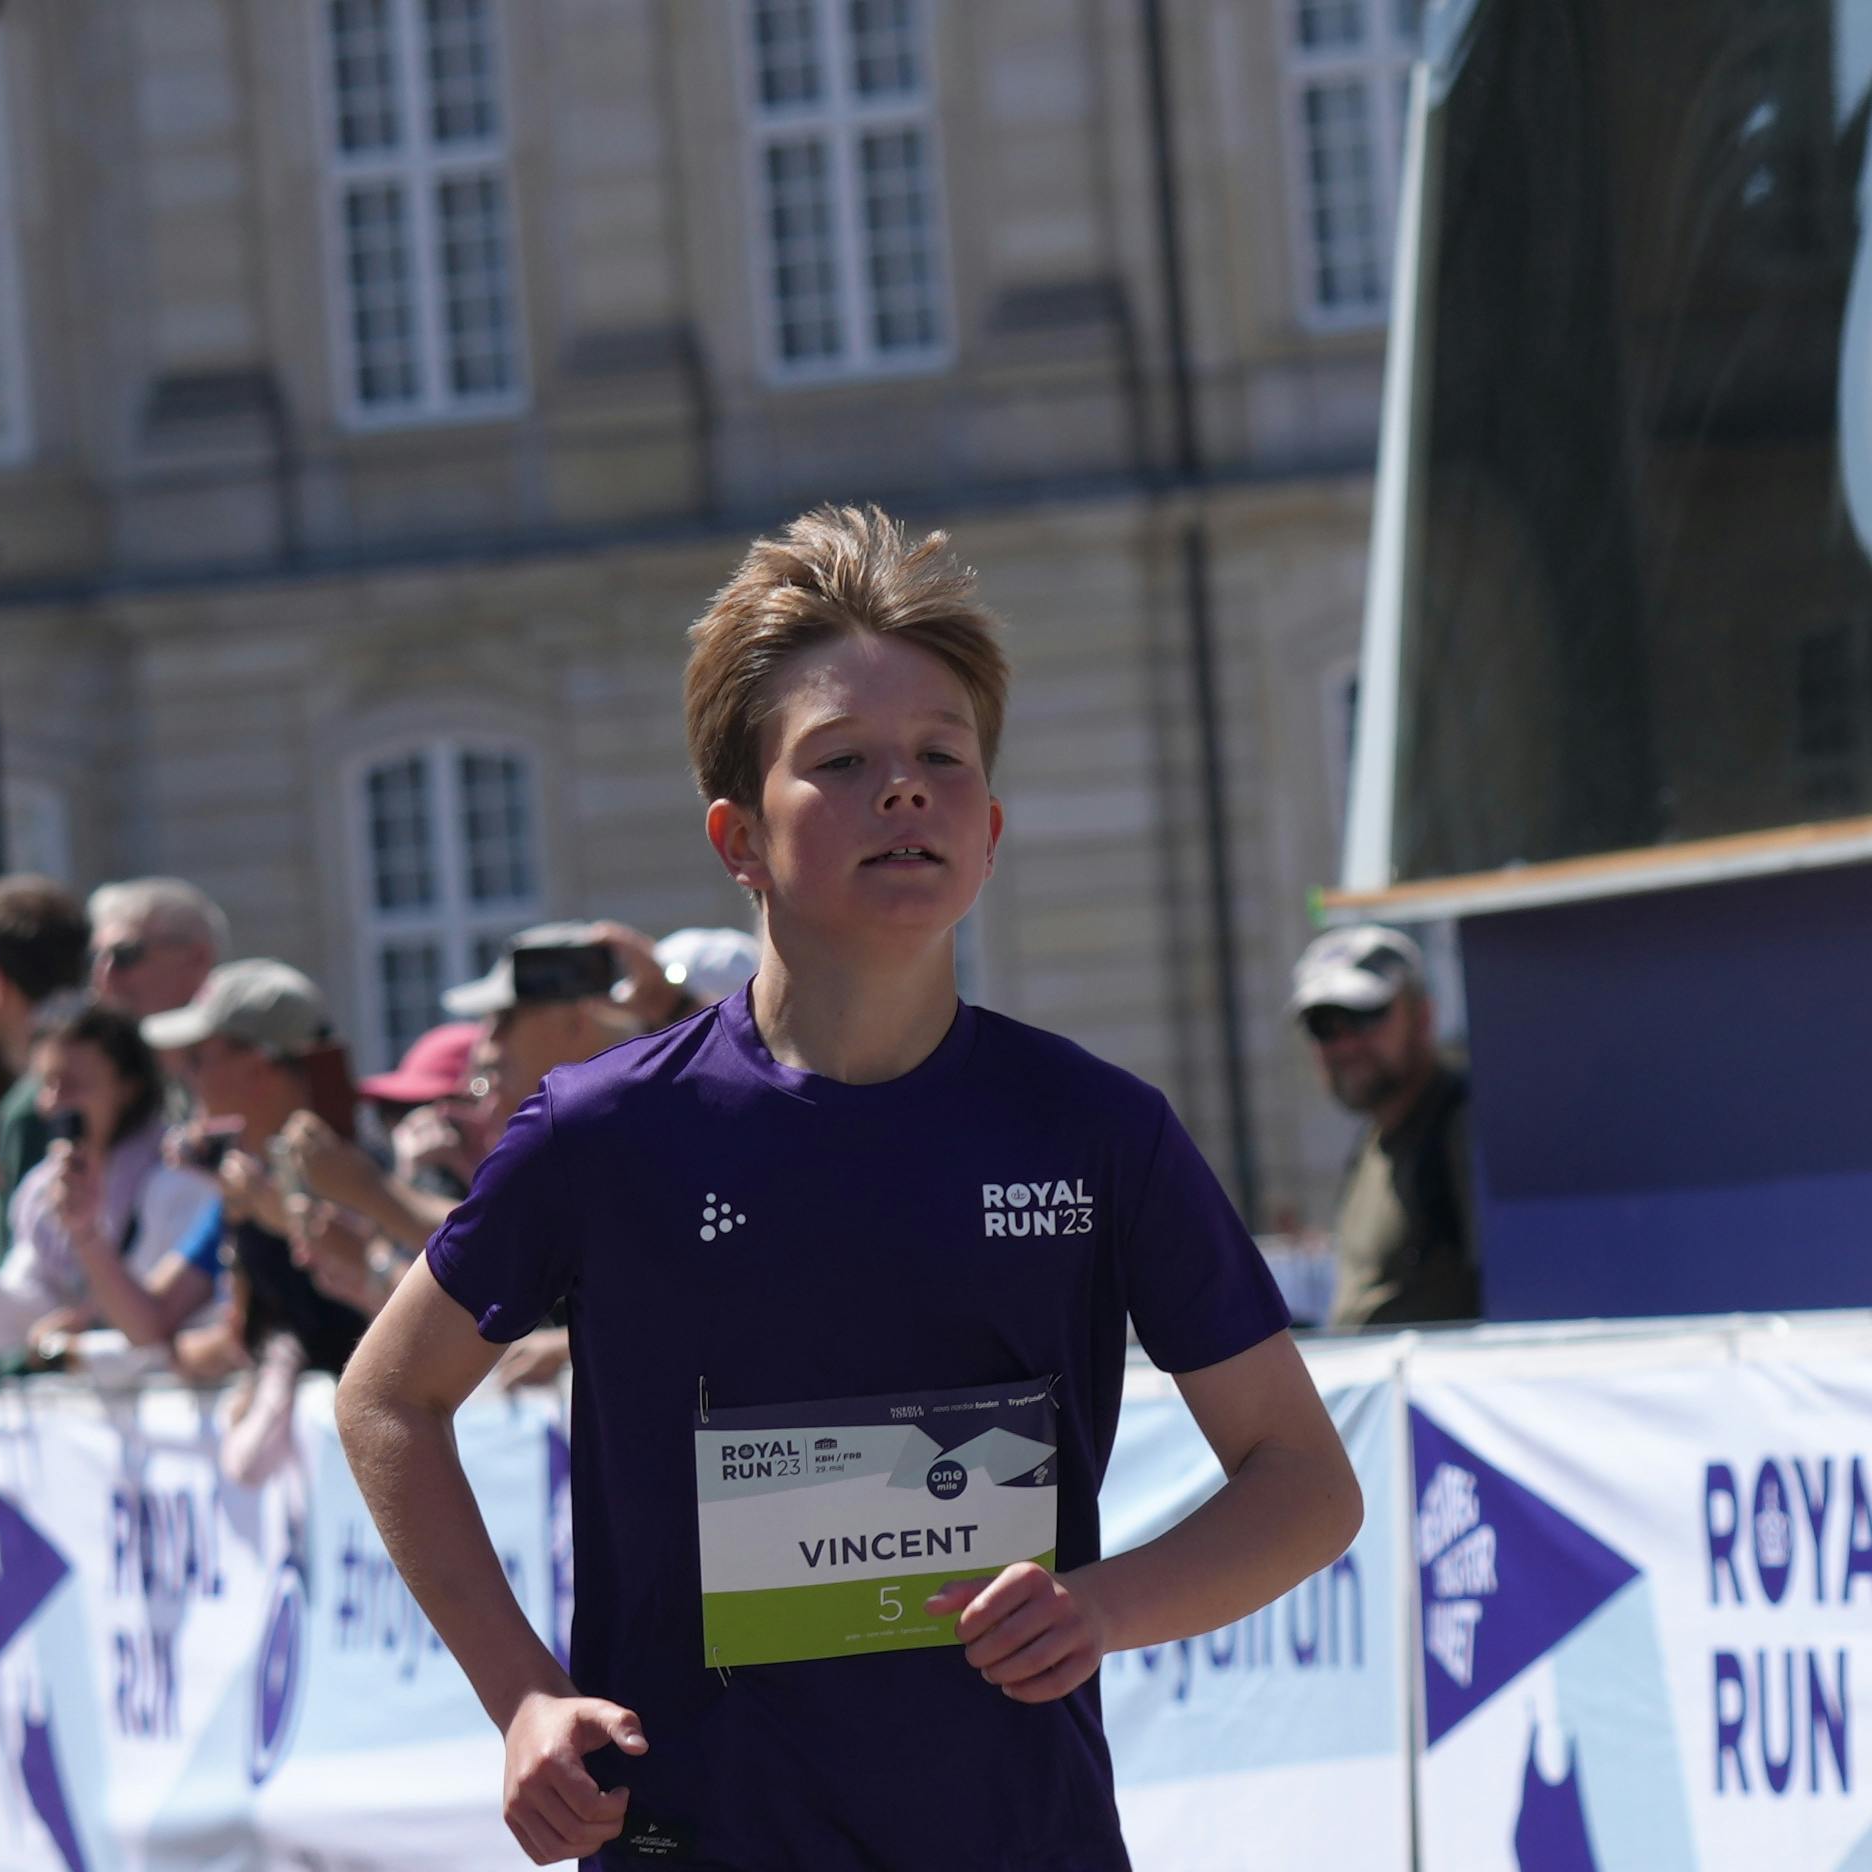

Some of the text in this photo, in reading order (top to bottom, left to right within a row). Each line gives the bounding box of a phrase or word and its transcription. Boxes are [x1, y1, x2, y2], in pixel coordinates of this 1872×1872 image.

[982, 1179, 1094, 1208] ROYAL
[721, 1440, 800, 1462] ROYAL
[815, 1454, 835, 1463] KBH
[843, 1451, 862, 1460] FRB
[931, 1469, 963, 1482] one
[936, 1482, 958, 1491] mile
[799, 1524, 979, 1569] VINCENT
[879, 1585, 904, 1621] 5
[1711, 1646, 1852, 1796] RUN
